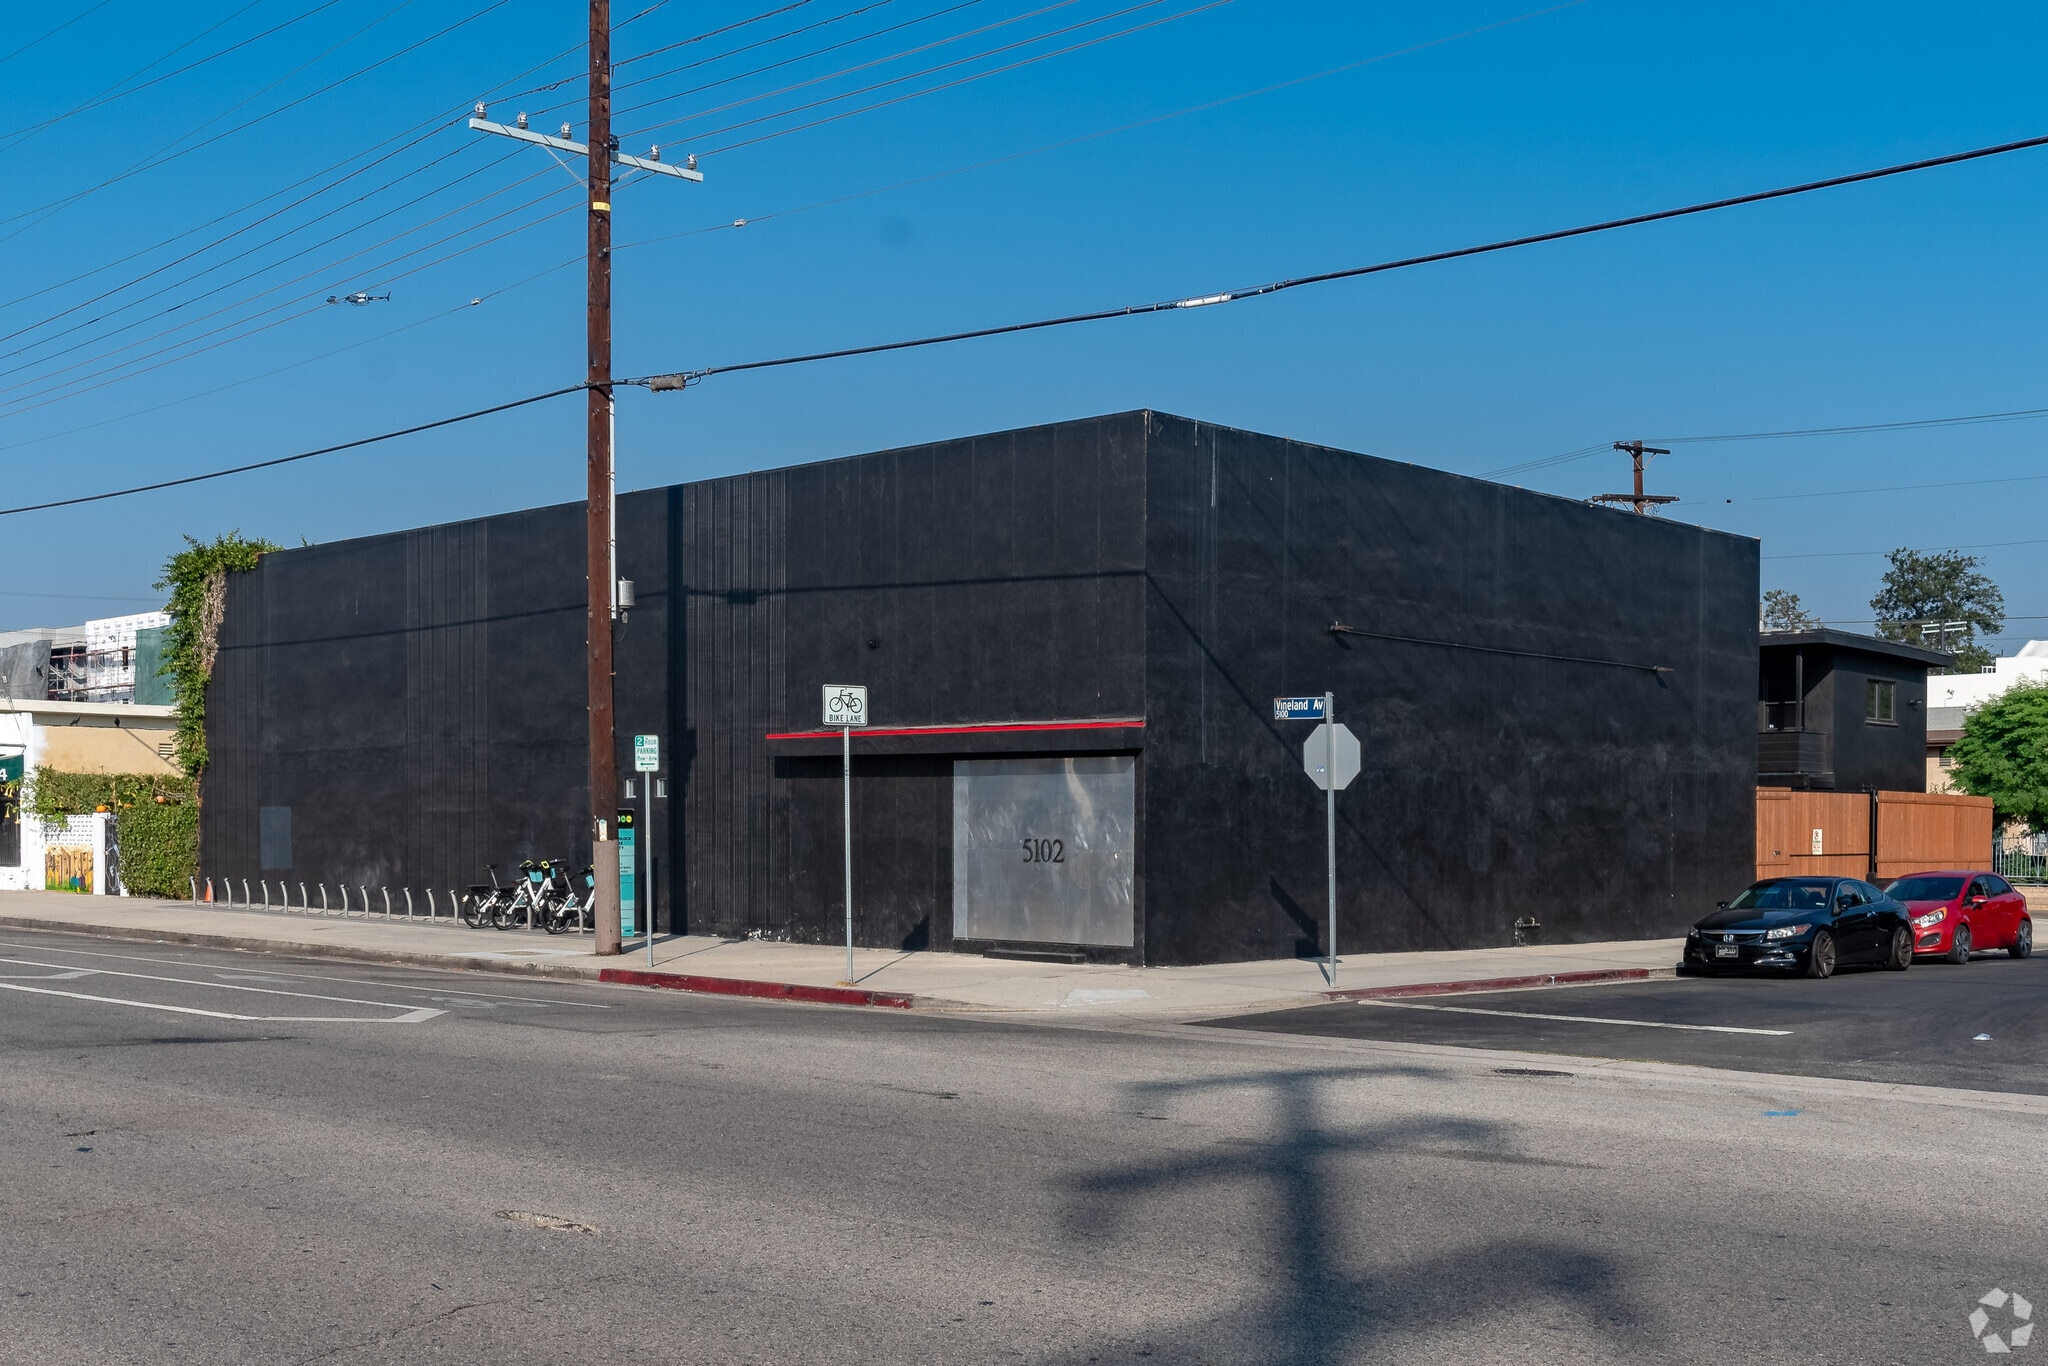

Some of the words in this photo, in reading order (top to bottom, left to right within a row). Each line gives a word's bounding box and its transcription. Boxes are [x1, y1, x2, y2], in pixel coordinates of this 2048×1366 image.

[1276, 699, 1308, 711] Vineland
[1313, 699, 1324, 710] Av
[829, 714, 844, 722] BIKE
[846, 714, 862, 723] LANE
[1276, 710, 1289, 718] 5100
[636, 737, 643, 746] 2
[645, 738, 657, 746] HOUR
[636, 747, 657, 755] PARKING
[1022, 838, 1065, 864] 5102
